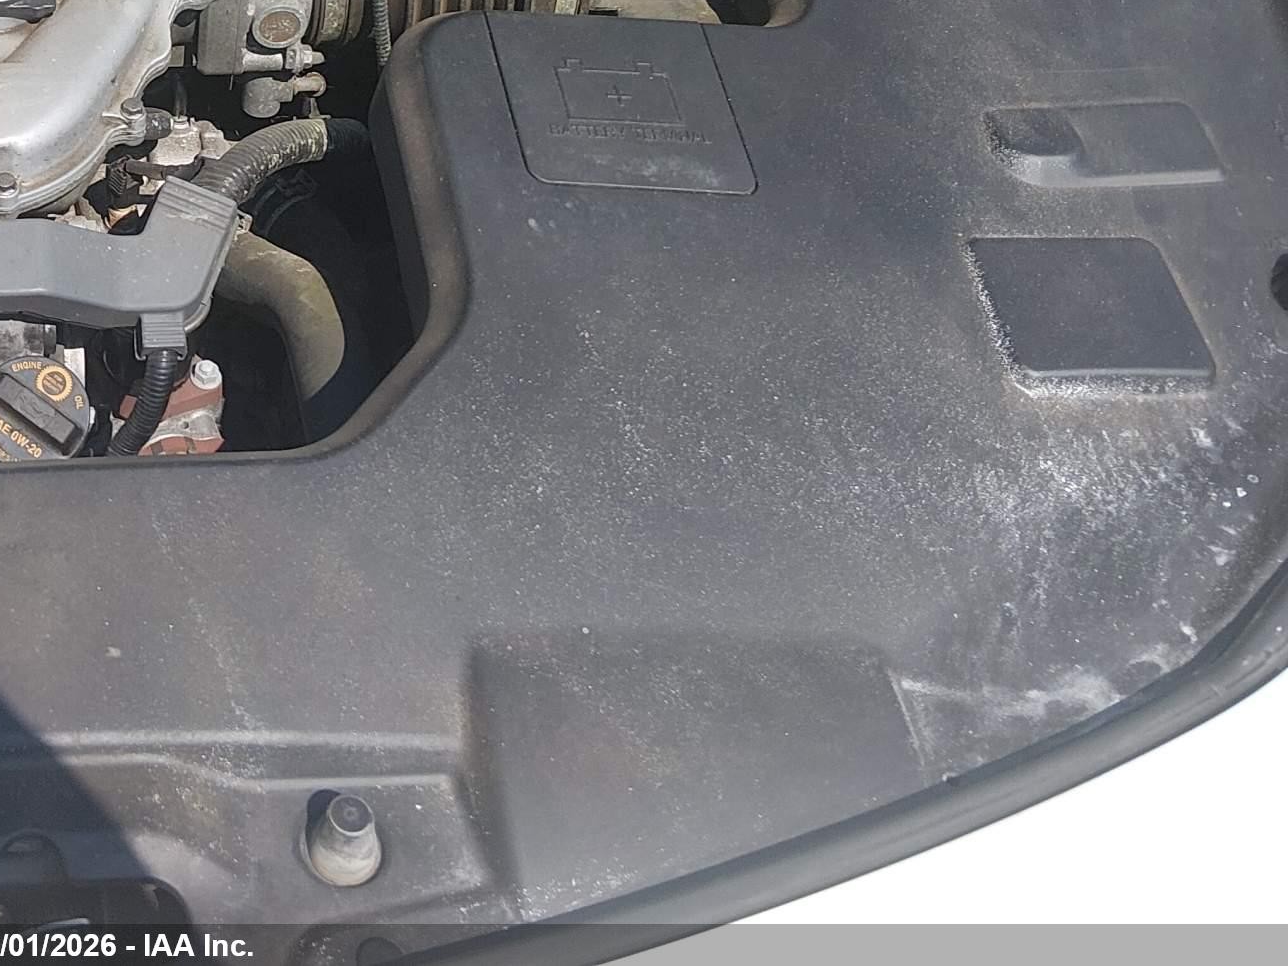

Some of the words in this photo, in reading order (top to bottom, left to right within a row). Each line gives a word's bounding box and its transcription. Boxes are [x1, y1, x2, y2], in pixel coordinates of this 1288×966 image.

[548, 123, 624, 139] BATTERY
[11, 361, 43, 372] ENGINE
[74, 395, 85, 410] OIL
[9, 430, 43, 459] 0W-20
